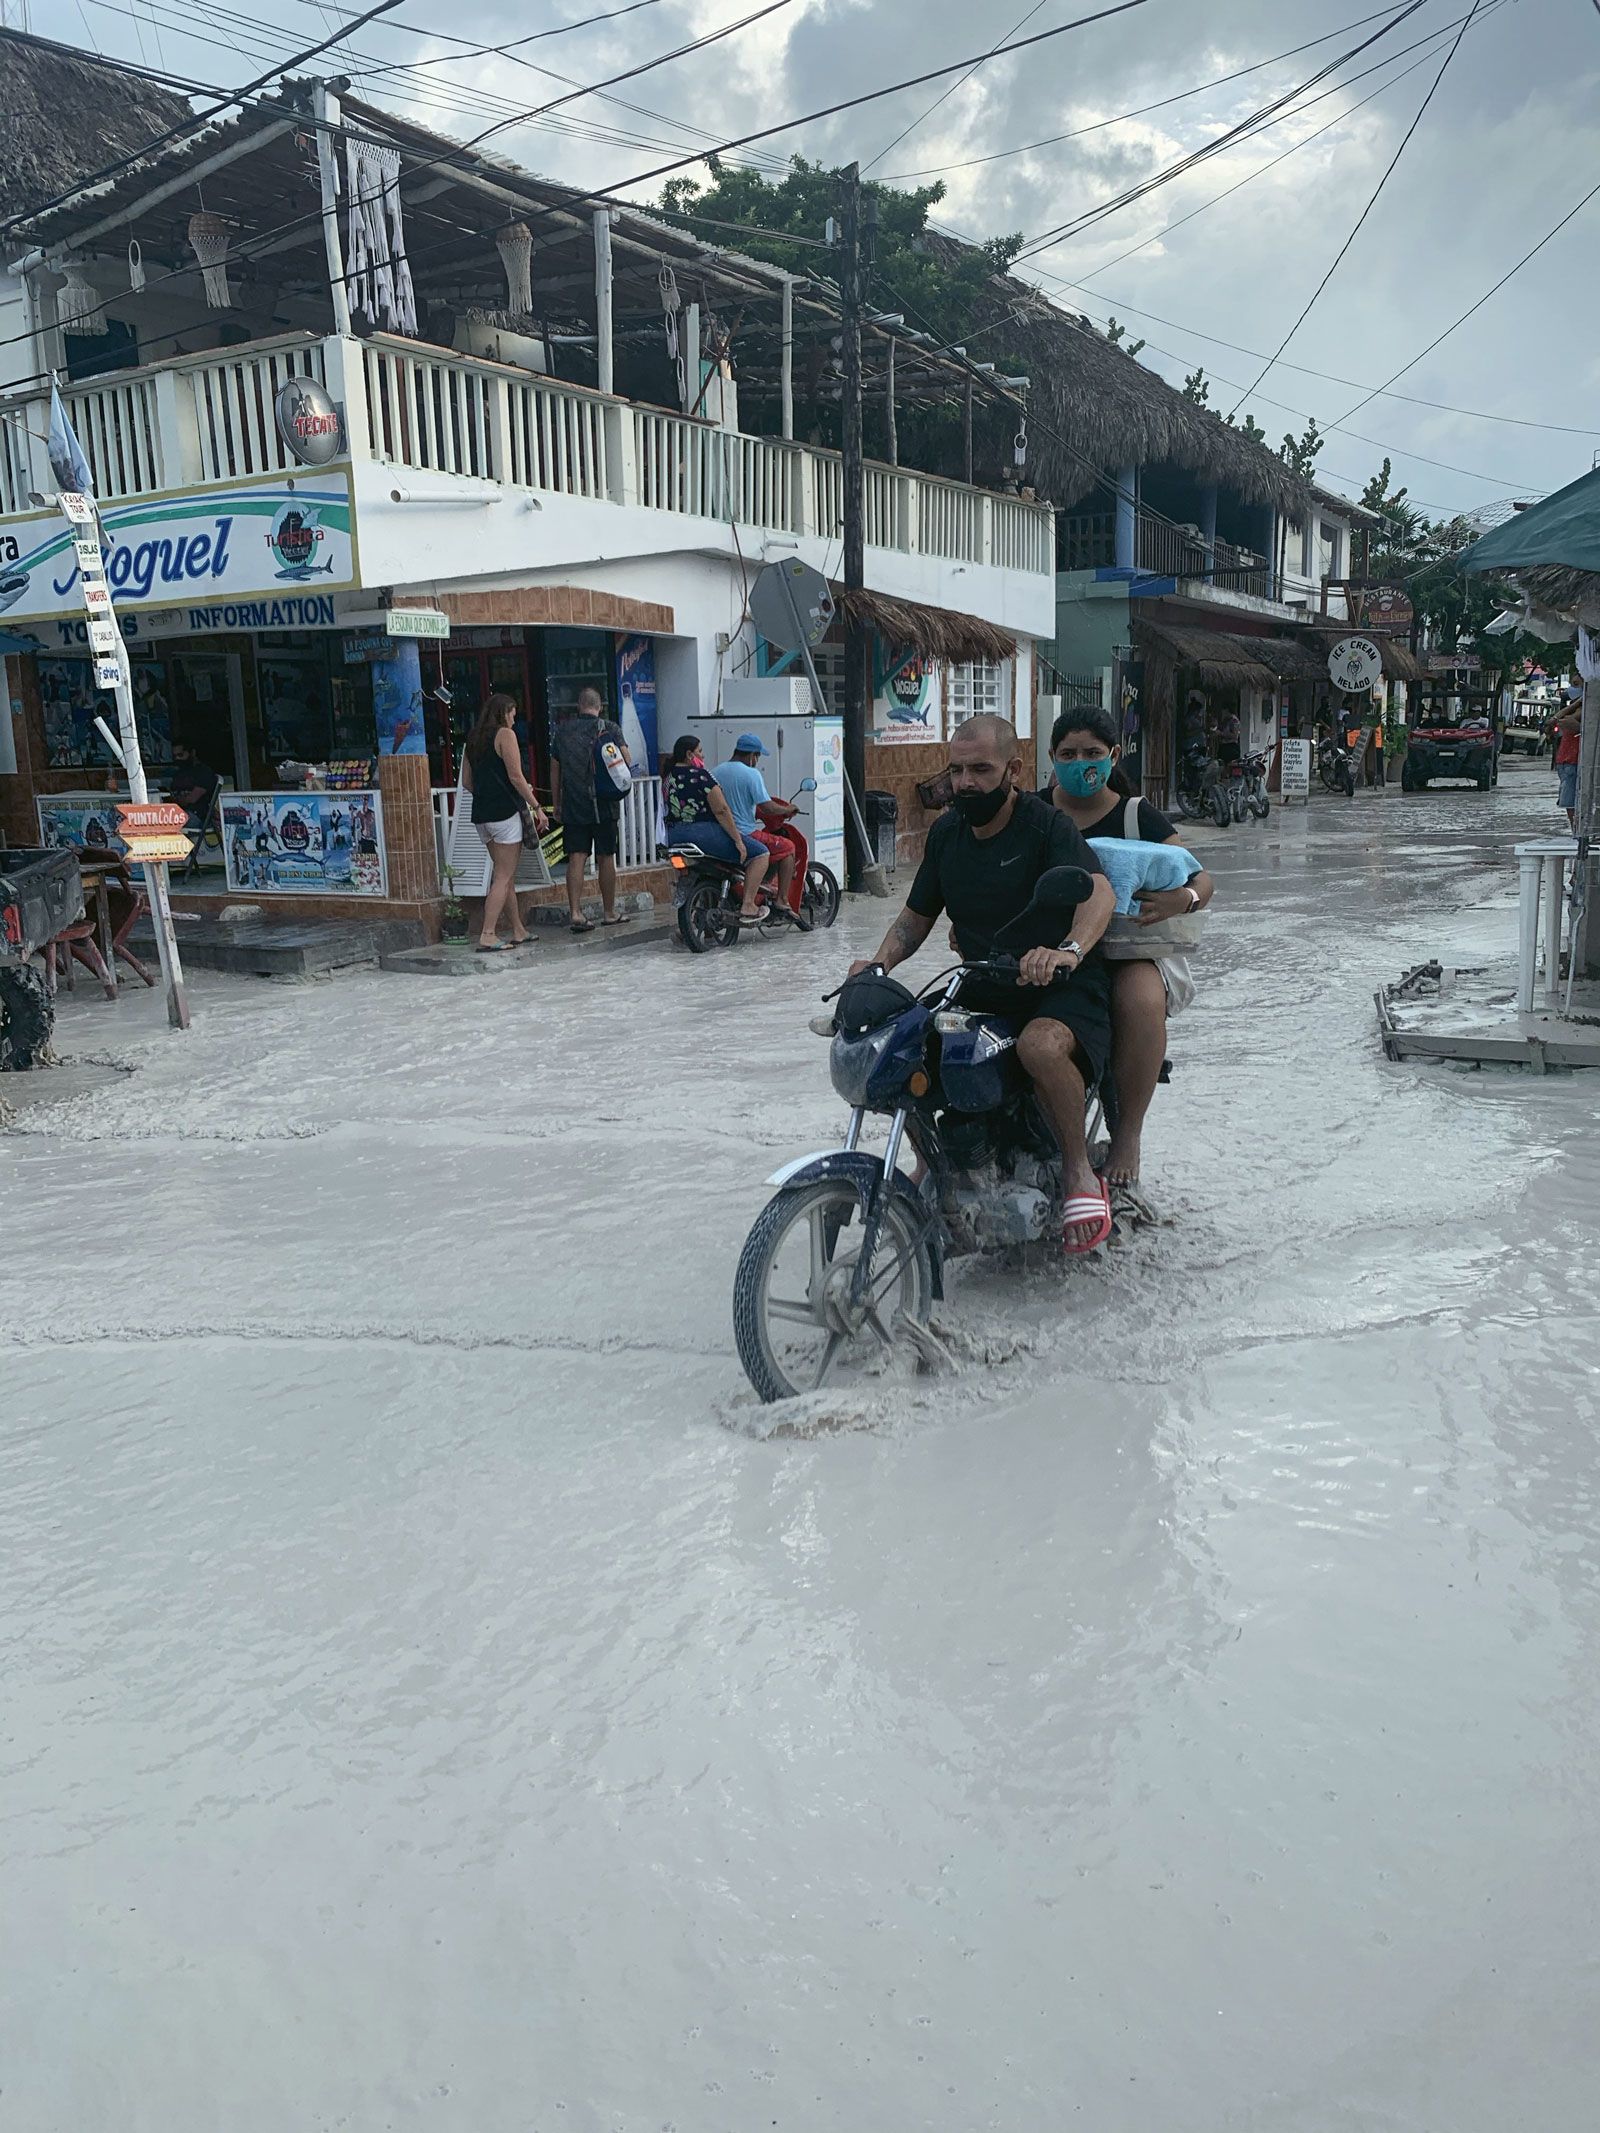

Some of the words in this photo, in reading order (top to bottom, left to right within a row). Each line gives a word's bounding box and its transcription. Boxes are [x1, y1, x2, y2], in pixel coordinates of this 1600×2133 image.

[292, 413, 338, 437] TECATE
[69, 504, 85, 514] TOUR
[1364, 589, 1410, 607] RESTAURANTE
[58, 614, 138, 646] TOS
[188, 594, 335, 630] INFORMATION
[1333, 645, 1346, 661] ICE
[1350, 640, 1377, 661] CREAM
[1337, 676, 1370, 690] HELADO
[127, 811, 158, 826] PUNTA
